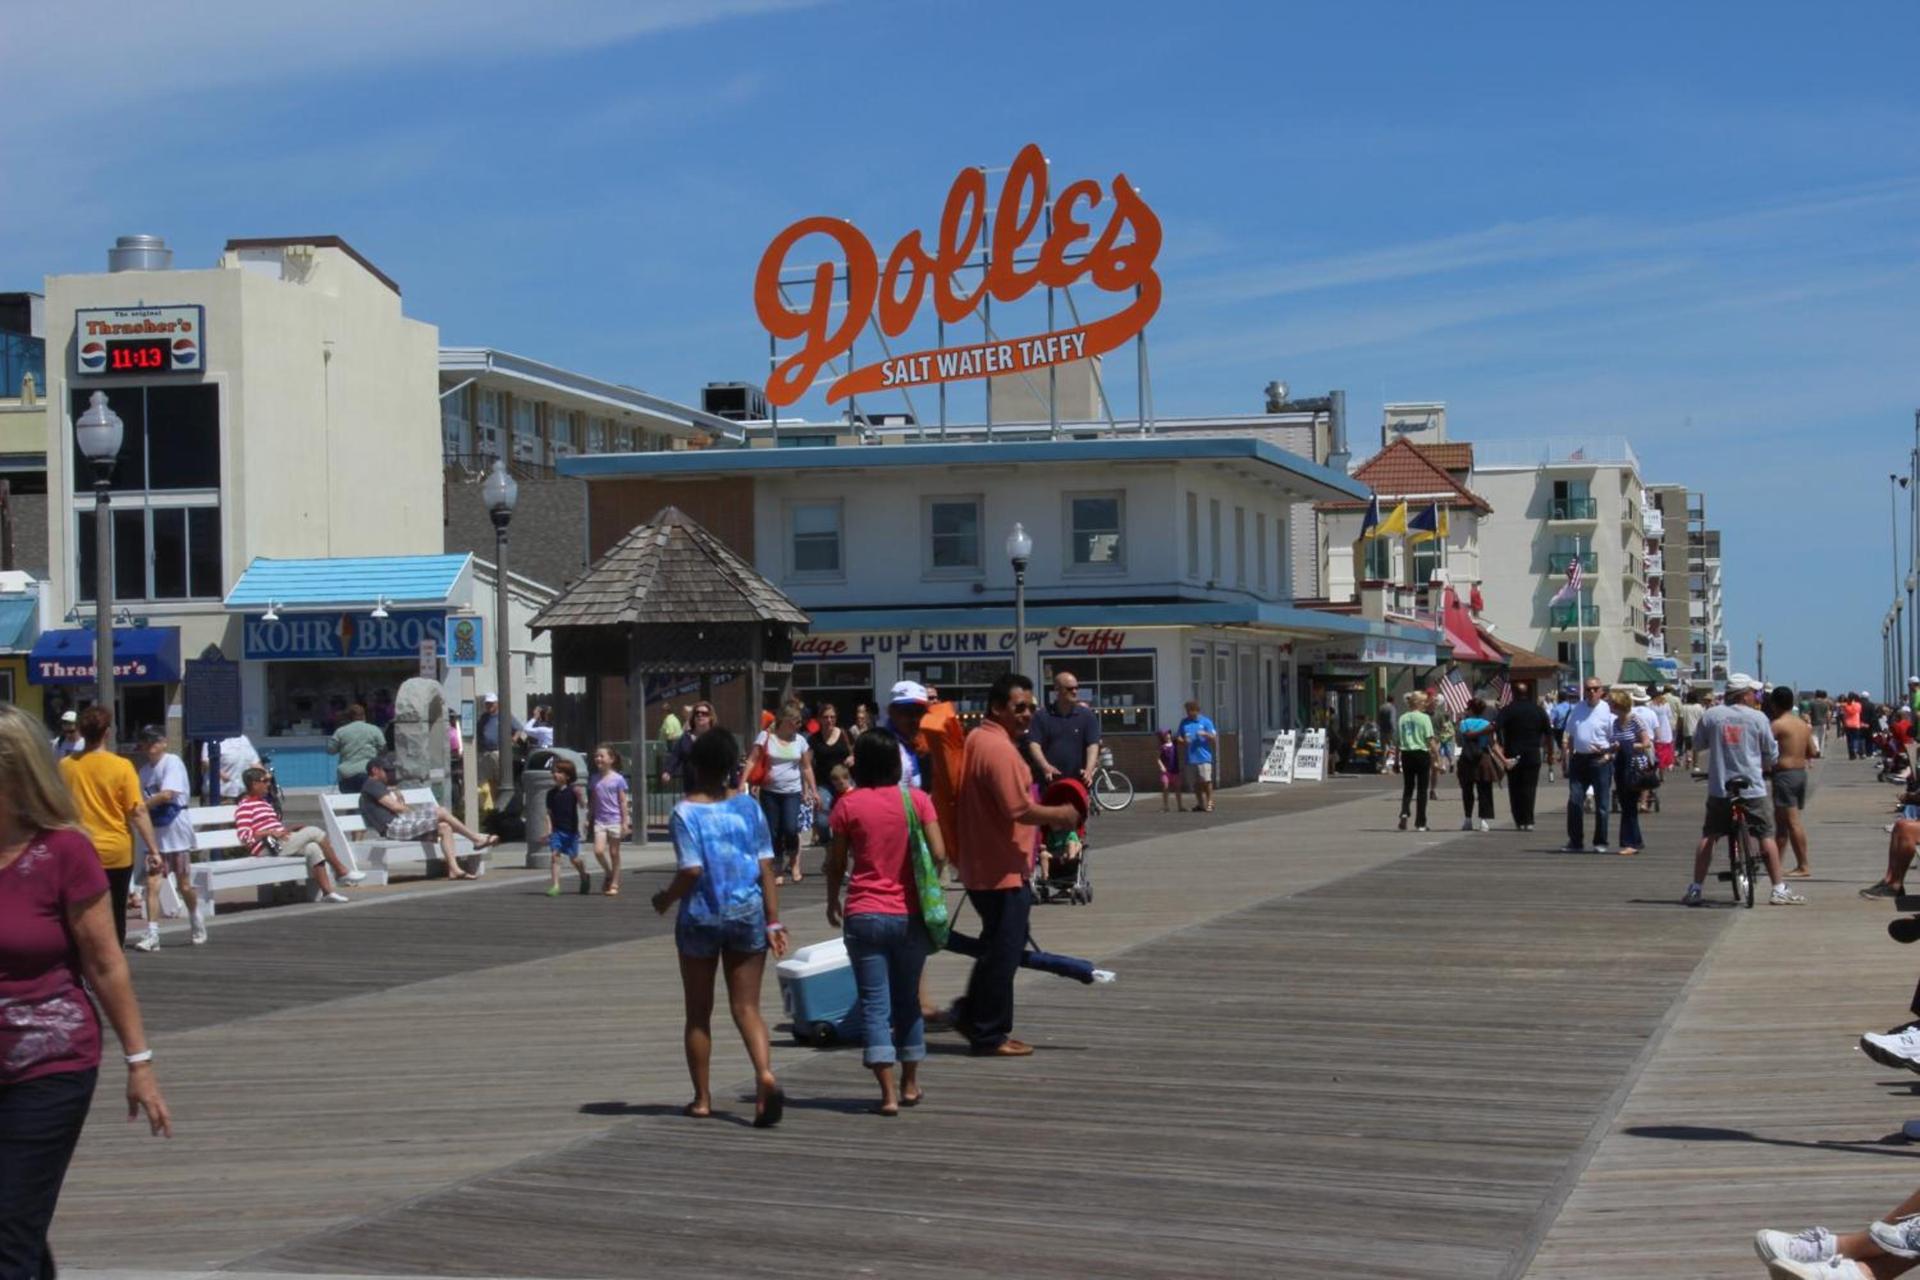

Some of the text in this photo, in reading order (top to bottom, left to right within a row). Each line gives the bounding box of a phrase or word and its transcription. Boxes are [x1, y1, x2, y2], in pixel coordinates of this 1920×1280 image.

[86, 318, 193, 336] Thrasher's
[111, 347, 162, 368] 11:13
[880, 331, 1086, 387] SALT WATER TAFFY
[247, 620, 333, 653] KOHR
[357, 617, 446, 650] BROS
[861, 633, 912, 653] POP
[919, 632, 988, 651] CORN
[1054, 626, 1126, 655] Taffy
[39, 661, 148, 677] Thraser's
